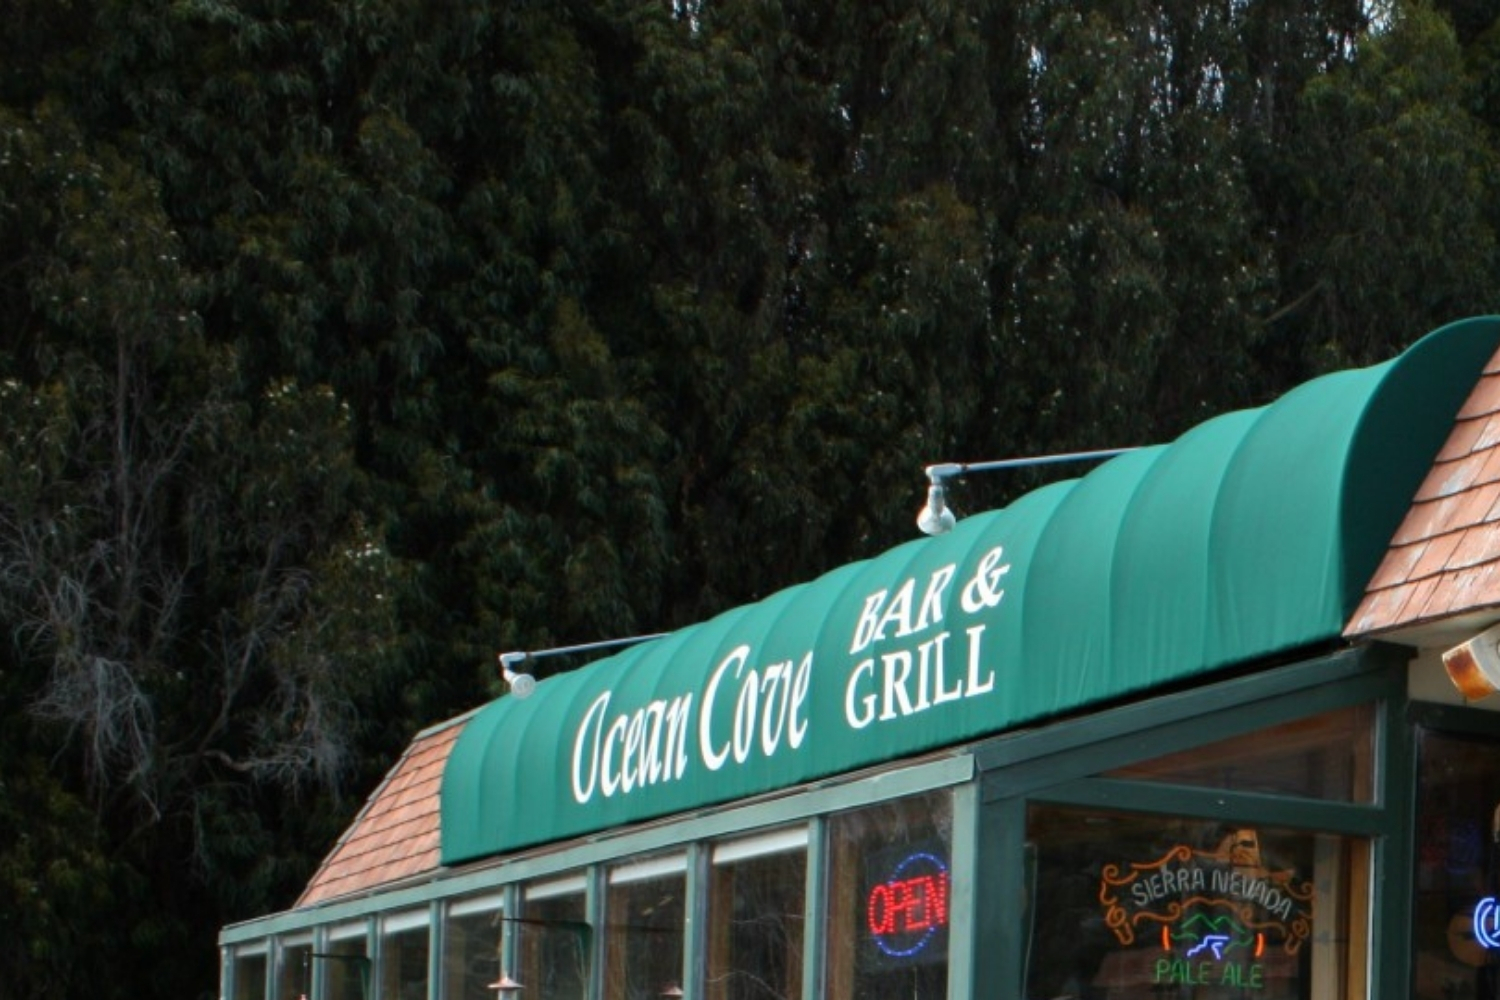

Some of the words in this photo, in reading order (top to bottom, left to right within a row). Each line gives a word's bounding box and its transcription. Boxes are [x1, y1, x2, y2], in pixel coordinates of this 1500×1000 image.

[850, 563, 956, 655] BAR
[961, 546, 1011, 612] &
[845, 624, 996, 729] GRILL
[571, 690, 693, 803] Ocean
[700, 645, 814, 771] Cove
[868, 873, 947, 935] OPEN
[1131, 868, 1205, 907] SIERRA
[1212, 869, 1292, 921] NEVADA
[1156, 958, 1212, 983] PALE
[1221, 962, 1264, 988] ALE
